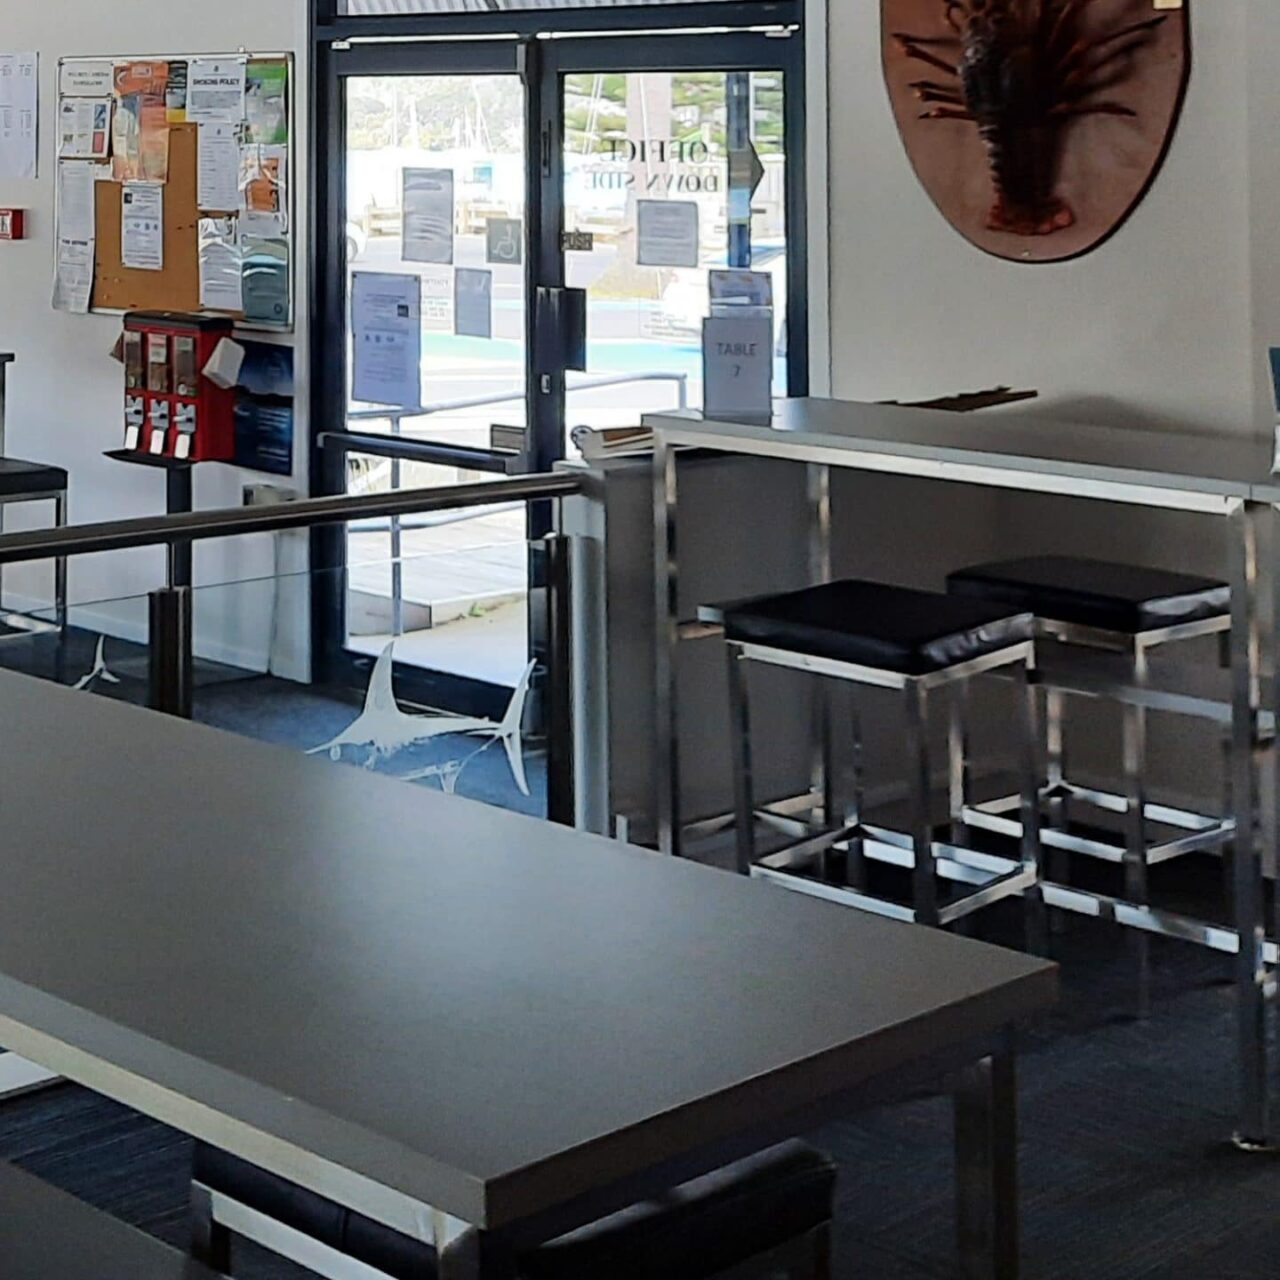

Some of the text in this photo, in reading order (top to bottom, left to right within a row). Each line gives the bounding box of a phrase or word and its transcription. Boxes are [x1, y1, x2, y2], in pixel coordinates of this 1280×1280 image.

[192, 78, 240, 86] SMOKING POLICY
[716, 342, 758, 357] TABLE
[732, 364, 742, 377] 7
